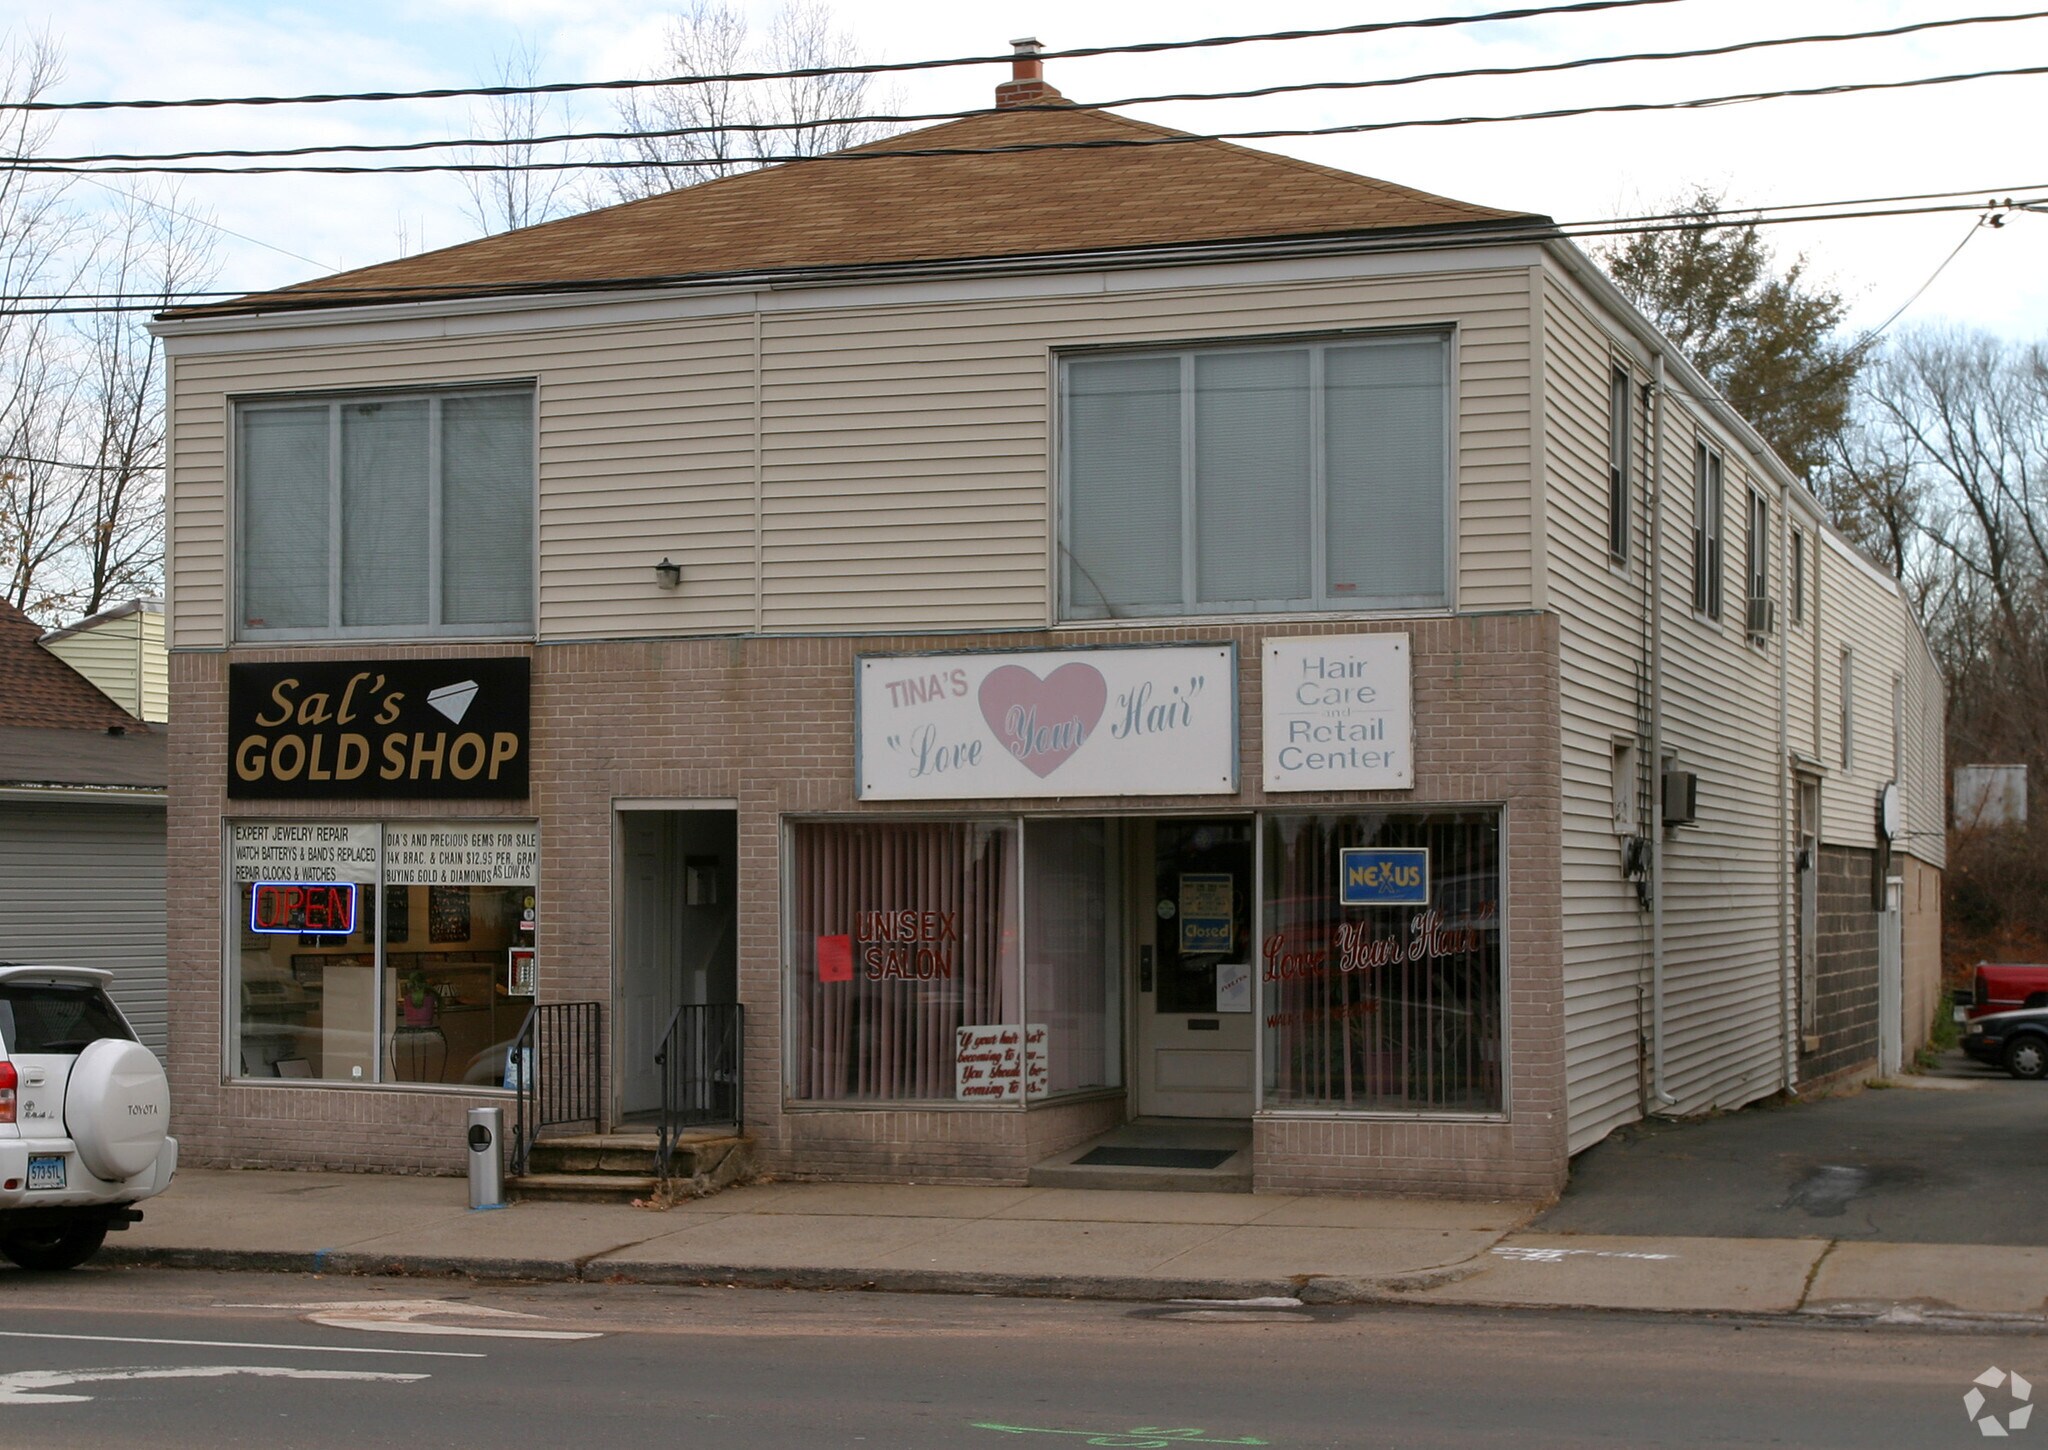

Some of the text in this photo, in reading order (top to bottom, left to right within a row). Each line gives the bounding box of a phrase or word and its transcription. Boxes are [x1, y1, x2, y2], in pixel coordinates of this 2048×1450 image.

[1302, 655, 1368, 679] Hair
[255, 671, 405, 728] Sal's
[885, 668, 968, 708] TINA'S
[1295, 682, 1377, 706] Care
[1005, 703, 1085, 761] Your
[1288, 718, 1384, 743] Retail
[235, 731, 520, 782] GOLD SHOP
[1278, 746, 1396, 771] Center
[235, 826, 349, 842] EXPERT JEWELRY REPAIR
[387, 833, 536, 848] DIA'S AND PRECIOUS GEMS FOR SALE
[235, 846, 260, 861] WATCH
[262, 846, 298, 861] BATTERYS
[300, 847, 305, 861] &
[337, 848, 377, 863] REPLACED
[387, 851, 400, 865] 14K
[429, 851, 436, 865] &
[439, 851, 463, 865] CHAIN
[466, 852, 492, 865] $12.95
[235, 865, 336, 882] REPAIR CLOCKS & WATCHES
[386, 869, 492, 883] BUYING GOLD & DIAMONDS
[492, 864, 531, 879] AS LOW AS
[255, 884, 352, 930] OPEN
[855, 910, 958, 944] UNISEX
[1184, 923, 1230, 938] Closed
[1335, 920, 1405, 973] Your
[865, 947, 952, 981] SALON
[127, 1104, 159, 1116] TOYOTA
